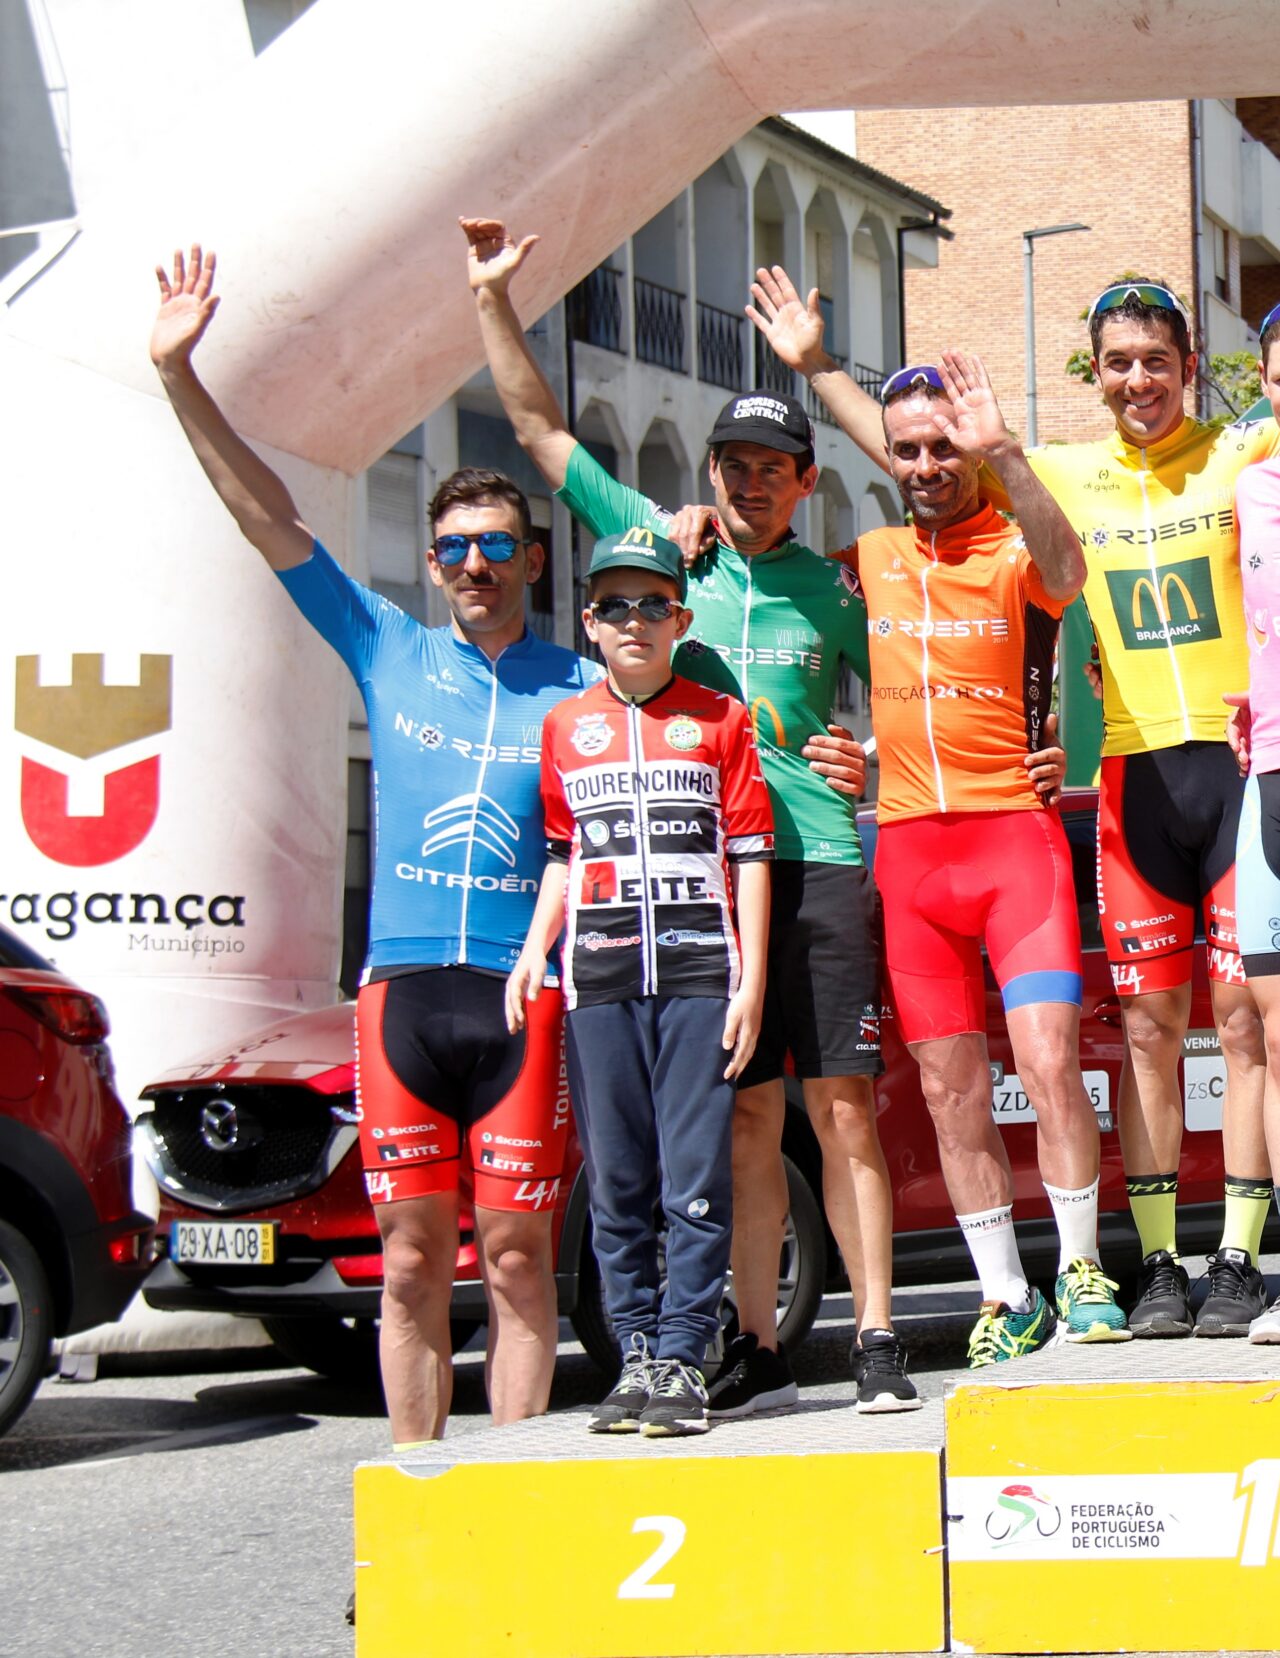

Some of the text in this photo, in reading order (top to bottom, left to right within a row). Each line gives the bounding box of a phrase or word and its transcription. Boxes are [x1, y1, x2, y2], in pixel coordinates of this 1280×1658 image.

[1136, 624, 1201, 641] BRAGANÇA
[565, 768, 714, 804] TOURENCINHO
[614, 819, 703, 838] ŠKODA
[0, 891, 246, 941] agança
[1131, 914, 1176, 929] ŠKODA
[387, 1123, 437, 1137] ŠKODA
[494, 1135, 543, 1148] ŠKODA
[1071, 1502, 1154, 1520] FEDERAÇÃO
[1072, 1520, 1165, 1534] PORTUGUESA
[1072, 1535, 1161, 1549] DE CICLISMO
[616, 1515, 688, 1599] 2
